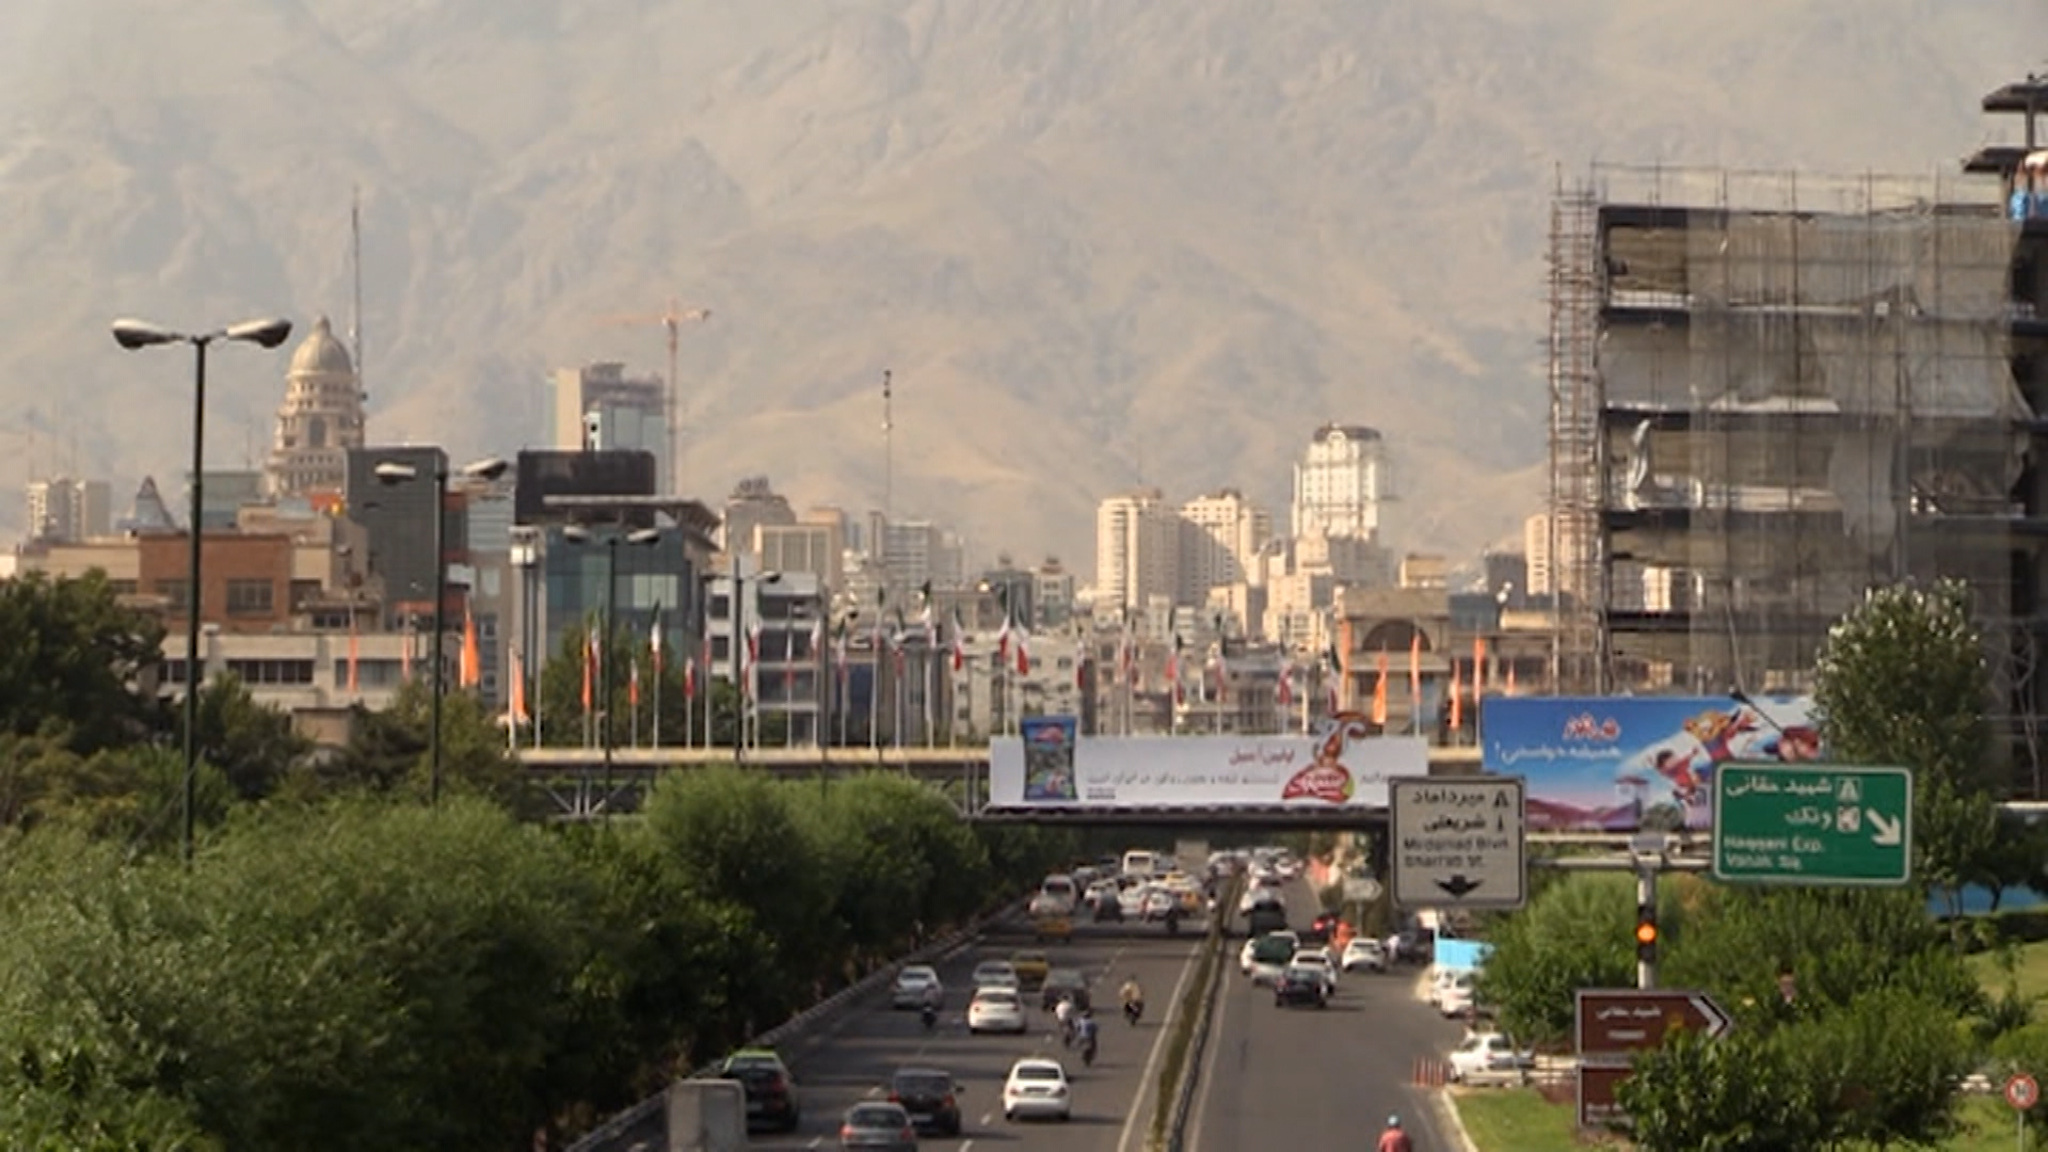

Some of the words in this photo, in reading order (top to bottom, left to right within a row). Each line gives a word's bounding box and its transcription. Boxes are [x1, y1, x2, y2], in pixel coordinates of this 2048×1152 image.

[1725, 775, 1780, 797] حقانی
[1784, 776, 1833, 796] شهید
[1413, 789, 1486, 808] میرداماد
[1423, 813, 1487, 834] شریعتی
[1784, 806, 1833, 830] ونک
